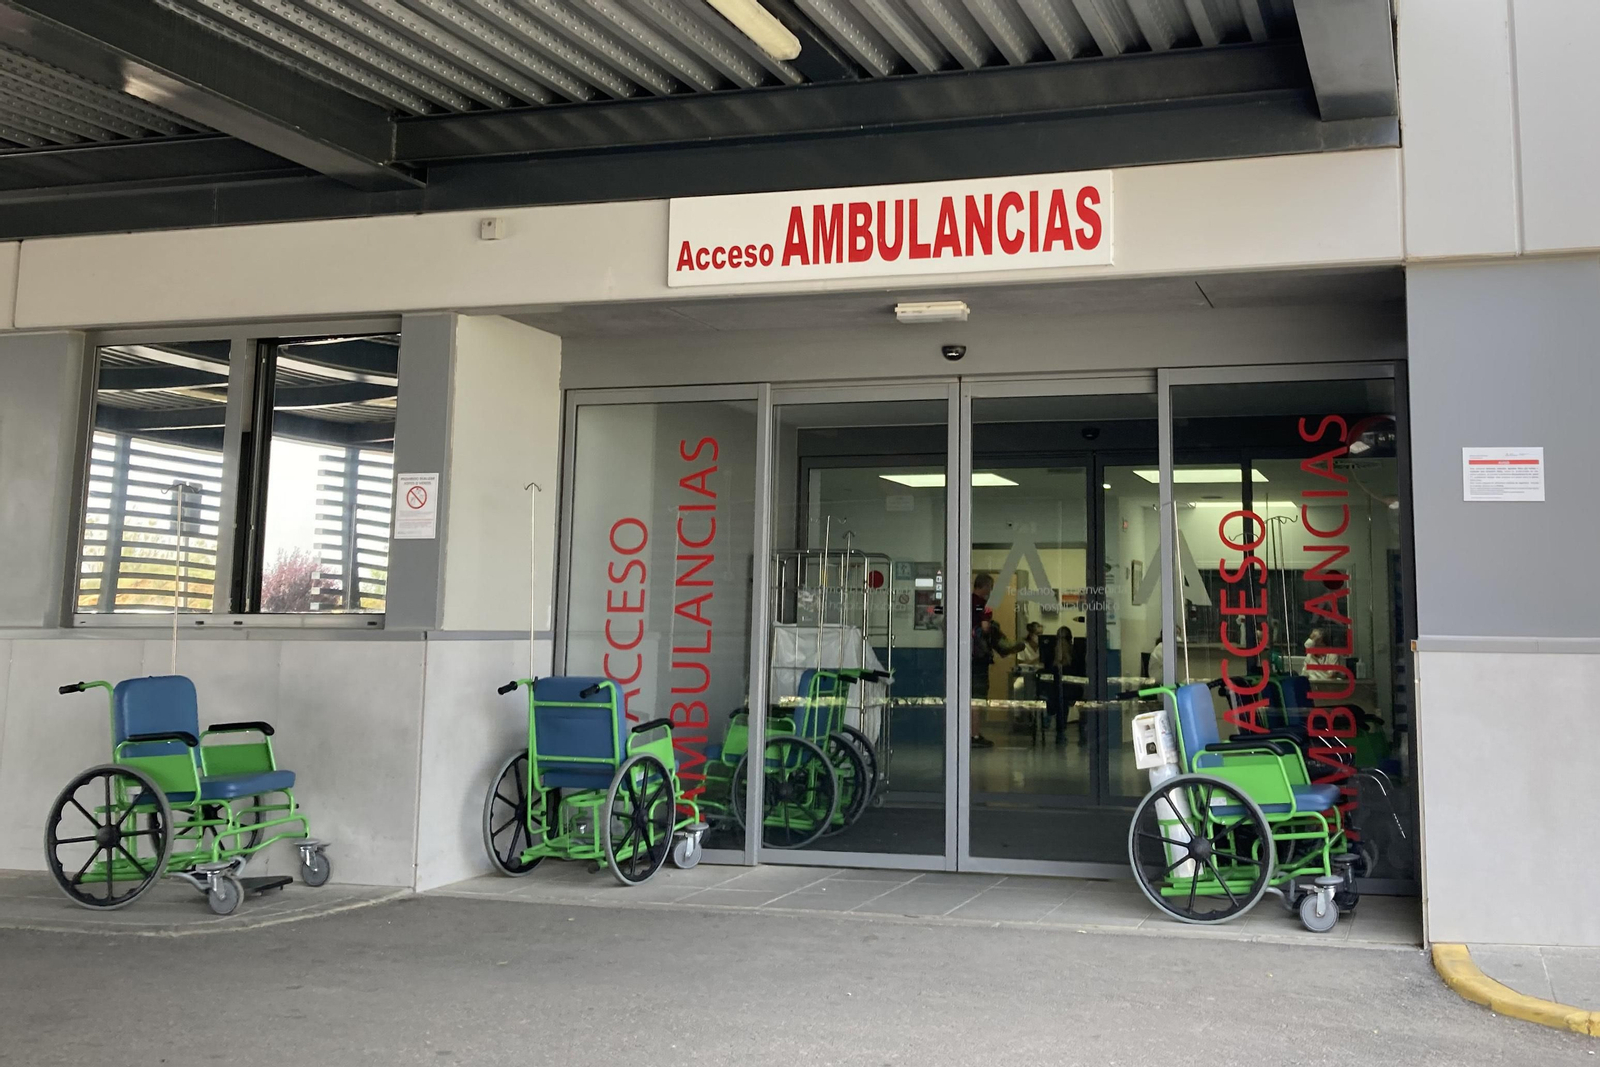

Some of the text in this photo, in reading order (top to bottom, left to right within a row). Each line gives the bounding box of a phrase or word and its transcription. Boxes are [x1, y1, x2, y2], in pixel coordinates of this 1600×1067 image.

[676, 185, 1102, 272] Acceso AMBULANCIAS
[669, 436, 720, 823] AMBULANCIAS
[1219, 509, 1270, 735] ACCESO
[1298, 413, 1361, 842] AMBULANCIAS
